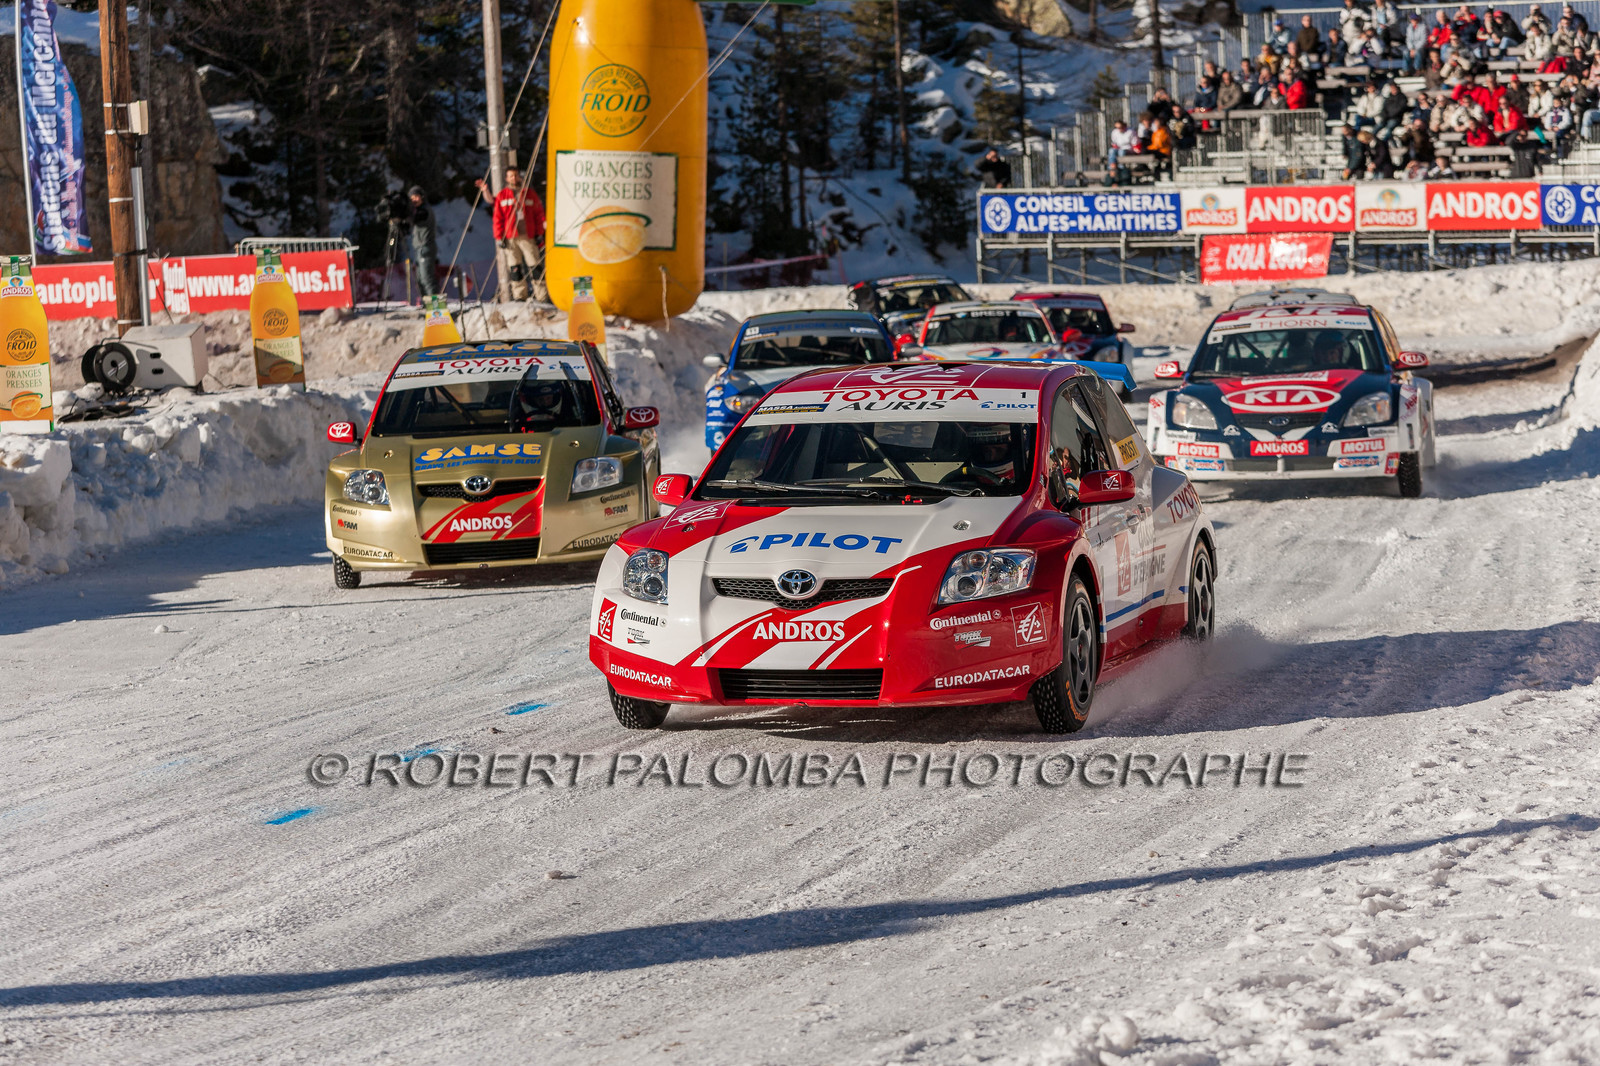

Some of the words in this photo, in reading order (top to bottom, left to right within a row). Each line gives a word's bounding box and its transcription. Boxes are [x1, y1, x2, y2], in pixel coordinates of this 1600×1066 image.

[580, 93, 651, 113] FROID
[34, 113, 57, 145] du
[574, 160, 654, 179] ORANGES
[573, 181, 653, 200] PRESSEES
[1014, 196, 1090, 214] CONSEIL
[1094, 194, 1176, 213] GENERAL
[1248, 194, 1353, 225] ANDROS
[1428, 190, 1540, 221] ANDROS
[1015, 212, 1178, 232] ALPES-MARITIMES
[1186, 211, 1237, 226] ANDROS
[1360, 210, 1417, 226] ANDROS
[1225, 242, 1266, 271] ISOLA
[2, 286, 33, 296] ANDROS
[970, 310, 1012, 318] BREST
[1256, 319, 1328, 330] THORN
[6, 340, 37, 352] FROID
[418, 342, 568, 356] SAMSE
[434, 357, 544, 370] TOYOTA
[1404, 353, 1424, 364] KIA
[6, 368, 42, 379] ORANGES
[447, 365, 523, 376] AURIS
[6, 379, 43, 390] PRESSEES
[822, 388, 980, 403] TOYOTA
[1020, 391, 1027, 399] 1
[1243, 390, 1321, 405] KIA
[835, 400, 949, 412] AURIS
[418, 443, 542, 463] SAMSE
[1178, 444, 1218, 457] MOTUL
[1254, 441, 1305, 455] ANDROS
[1343, 439, 1385, 453] MOTUL
[600, 489, 631, 504] Continental
[613, 504, 628, 515] FAM
[449, 515, 513, 532] ANDROS
[759, 532, 903, 554] PILOT
[343, 546, 394, 558] EURODATACAR
[620, 608, 660, 627] Continental
[929, 610, 992, 631] Continental
[752, 621, 846, 642] ANDROS
[609, 663, 673, 688] EURODATACAR
[934, 664, 1031, 689] EURODATACAR
